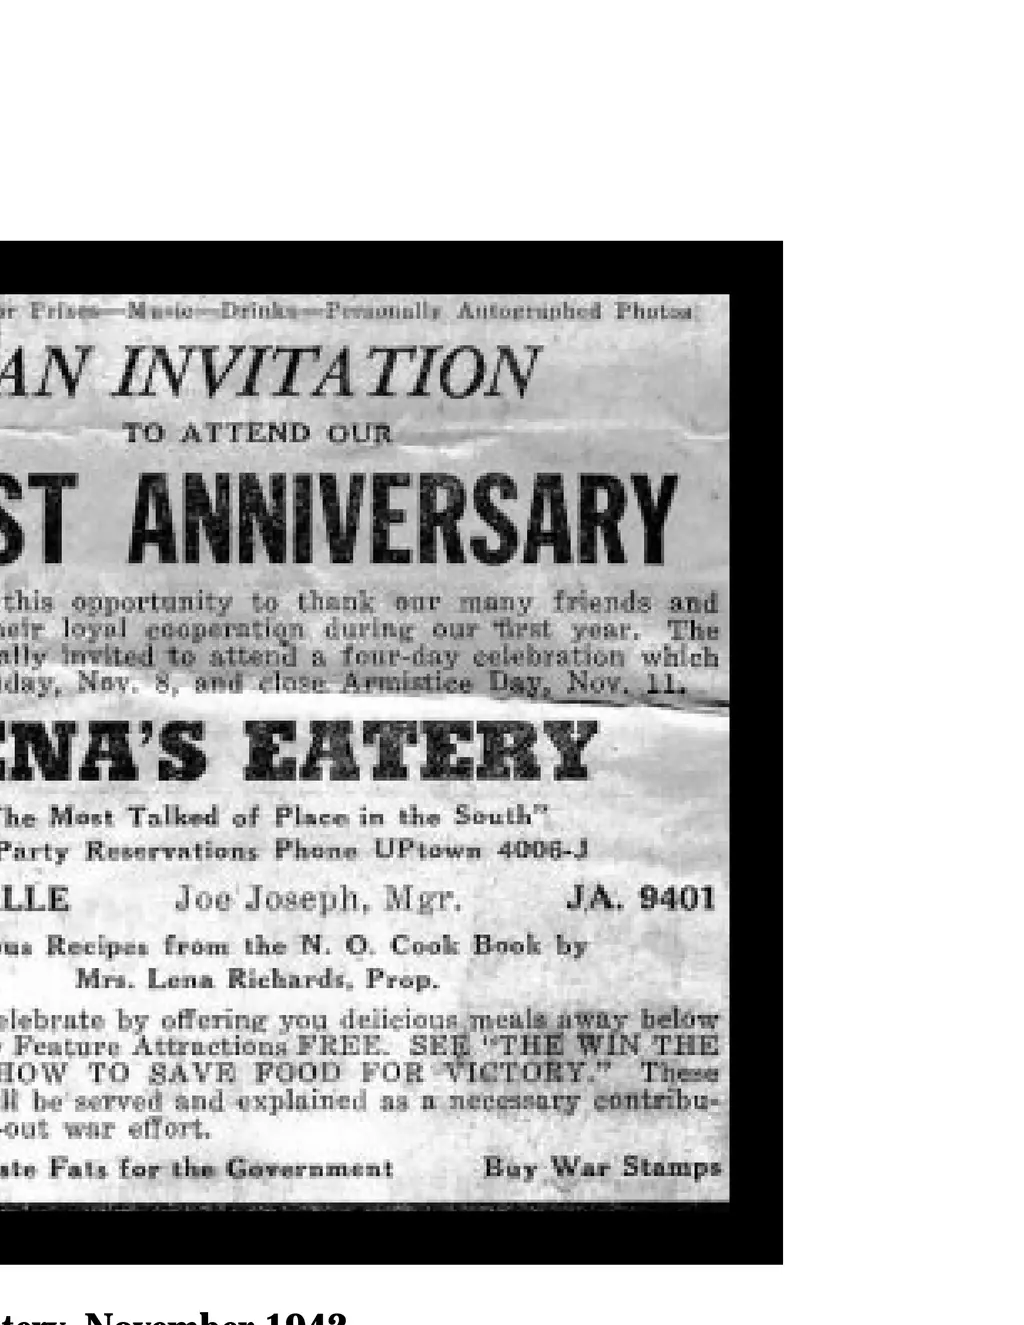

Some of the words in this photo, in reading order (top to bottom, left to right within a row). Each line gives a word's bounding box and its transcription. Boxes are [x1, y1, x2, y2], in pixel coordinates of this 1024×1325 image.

[109, 345, 544, 399] INVITATION
[122, 422, 166, 443] TO
[179, 422, 310, 443] ATTEND
[326, 422, 394, 443] OUR
[128, 473, 678, 566] ANNIVERSARY
[243, 720, 597, 781] EATERY
[48, 804, 115, 827] Most
[125, 804, 219, 827] Talked
[232, 804, 260, 827] of
[276, 804, 350, 827] Place
[359, 804, 384, 827] in
[399, 804, 441, 827] the
[85, 839, 259, 862] Reservations
[276, 837, 360, 861] Phone
[371, 837, 484, 862] UPtown
[497, 837, 590, 861] 4006-J
[175, 884, 233, 912] Joe
[567, 884, 624, 911] JA.
[638, 884, 715, 912] 9401
[45, 934, 149, 960] Recipes
[163, 934, 230, 958] from
[245, 934, 287, 955] the
[390, 934, 460, 957] Cook
[473, 934, 541, 956] Book
[556, 934, 588, 958] by
[148, 968, 216, 989] Lena
[48, 1155, 109, 1179] Fats
[120, 1157, 161, 1179] for
[171, 1157, 217, 1179] the
[225, 1157, 393, 1179] Government
[483, 1156, 537, 1181] Buy
[550, 1156, 611, 1177] War
[622, 1156, 722, 1182] Stamps
